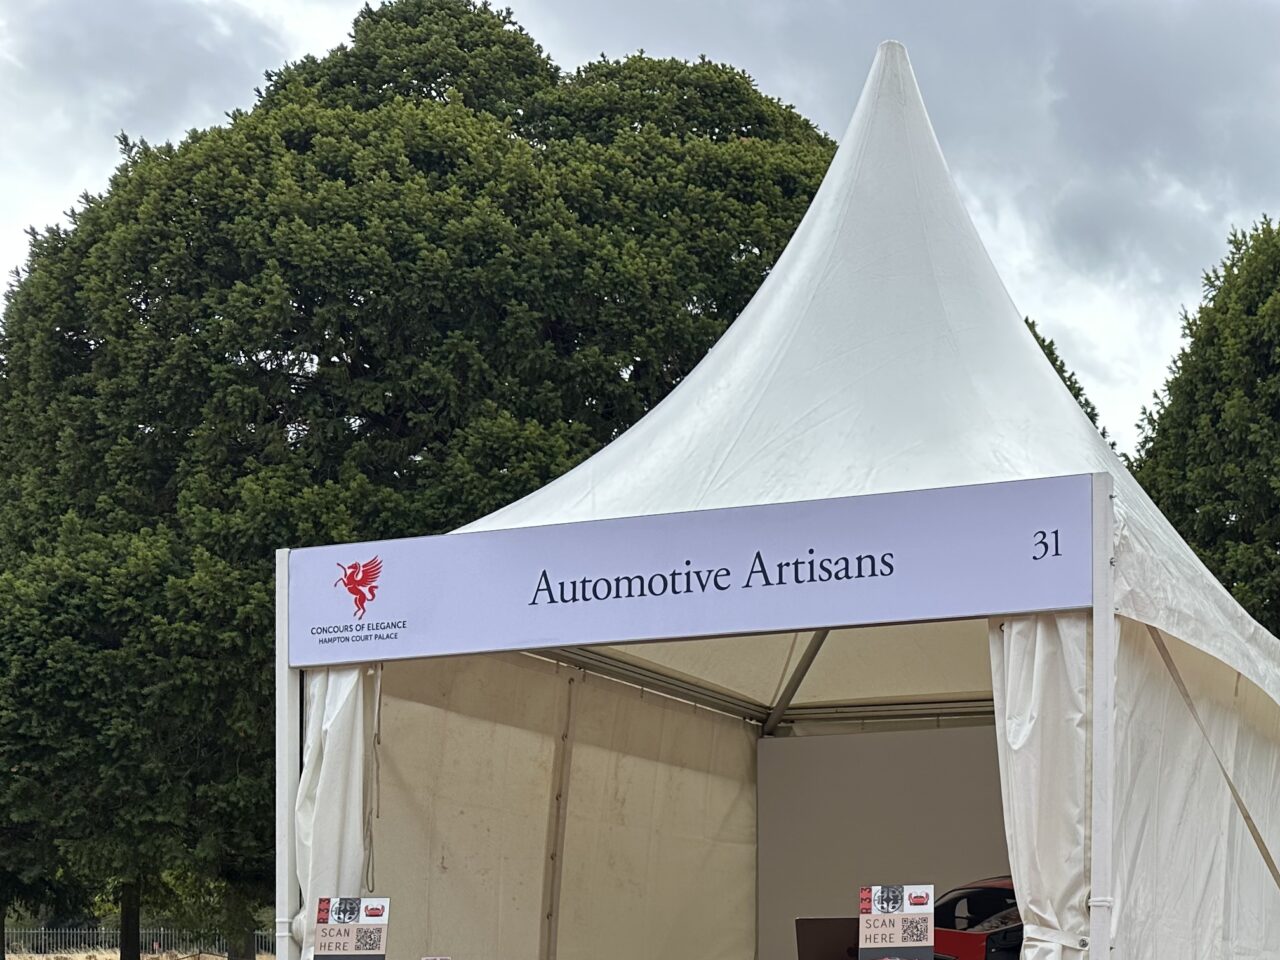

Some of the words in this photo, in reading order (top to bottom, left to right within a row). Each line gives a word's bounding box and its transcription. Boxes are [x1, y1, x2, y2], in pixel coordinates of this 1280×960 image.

[1032, 529, 1063, 561] 31
[528, 559, 732, 606] Automotive
[741, 548, 895, 589] Artisans
[310, 624, 353, 635] CONCOURS
[355, 623, 365, 631] OF
[367, 620, 407, 631] ELEGANCE
[318, 635, 350, 645] HAMPTON
[351, 633, 373, 643] COURT
[374, 632, 398, 641] PALACE
[865, 919, 895, 928] SCAN
[321, 928, 350, 938] SCAN
[864, 933, 895, 943] HERE
[319, 942, 349, 951] HERE
